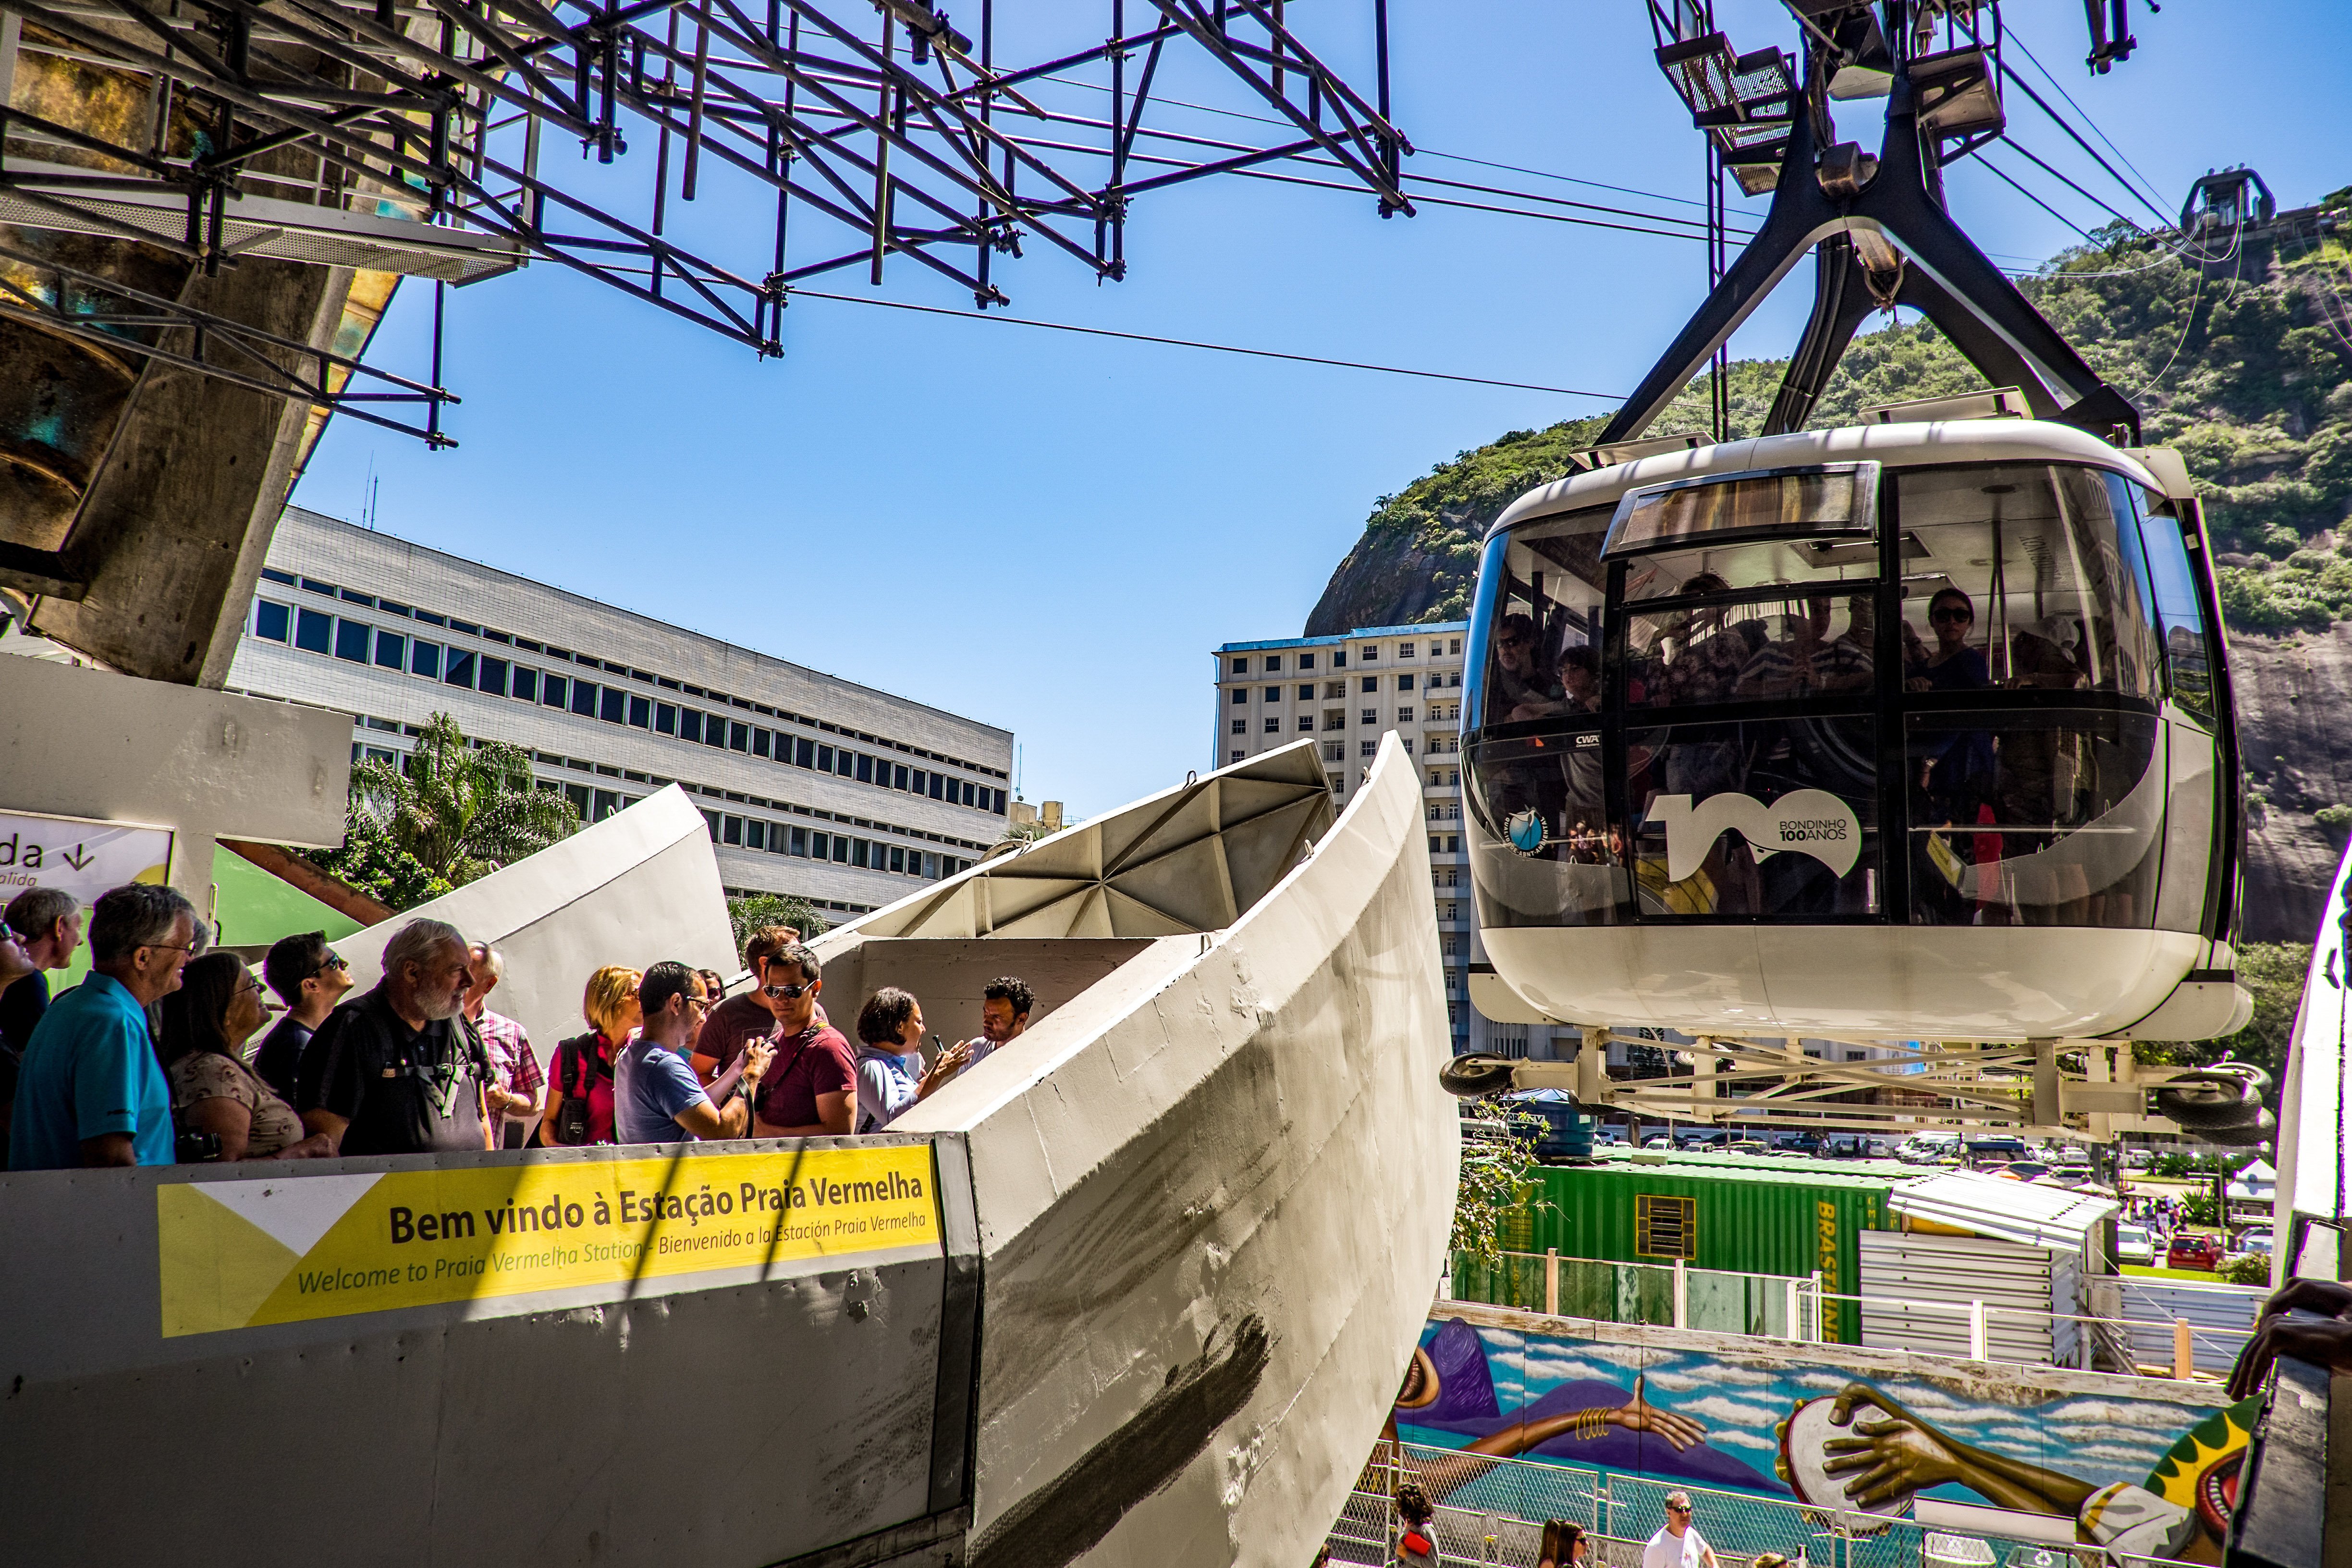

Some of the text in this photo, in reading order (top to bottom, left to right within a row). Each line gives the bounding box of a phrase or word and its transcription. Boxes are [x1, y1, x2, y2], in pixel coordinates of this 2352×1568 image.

[1576, 735, 1599, 744] CWA
[1780, 819, 1846, 830] BONDINHO
[390, 1171, 923, 1244] Bem vindo à Estação Praia Vermelha
[298, 1265, 400, 1295] Welcome
[407, 1263, 428, 1282] to
[435, 1253, 486, 1280] Praia
[492, 1245, 578, 1274] Vermelha
[583, 1241, 643, 1263] Station
[659, 1229, 741, 1255] Bienvenido
[746, 1232, 754, 1244] a
[758, 1225, 771, 1243] la
[776, 1220, 830, 1242] Estación
[834, 1217, 867, 1235] Praia
[870, 1212, 926, 1231] Vermelha
